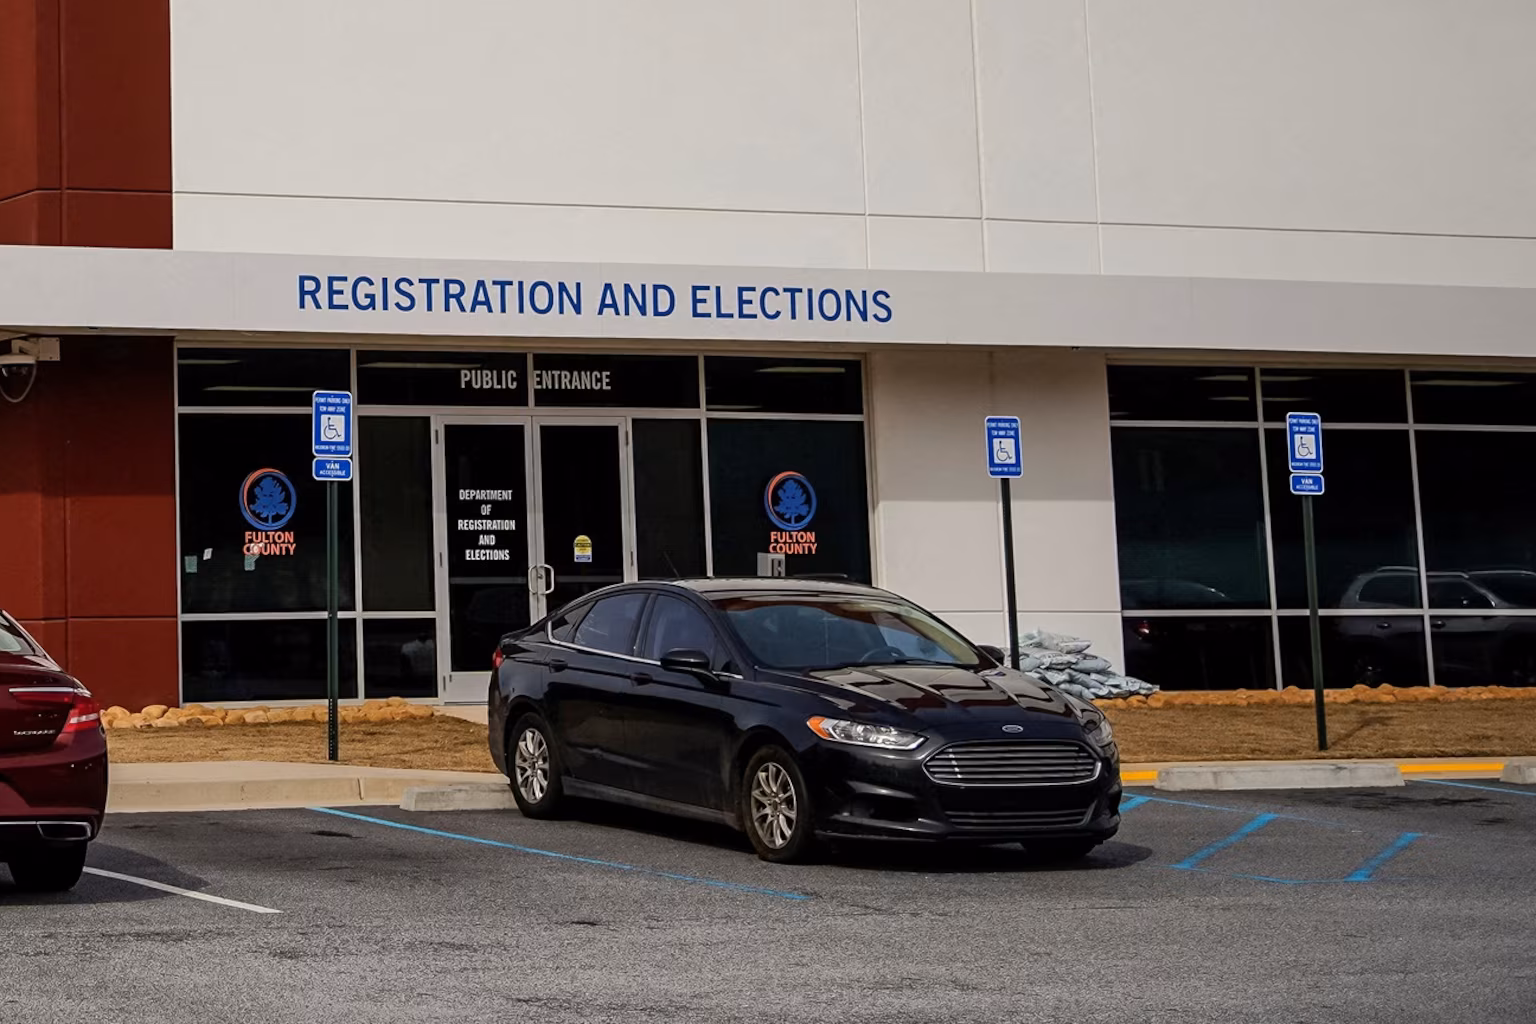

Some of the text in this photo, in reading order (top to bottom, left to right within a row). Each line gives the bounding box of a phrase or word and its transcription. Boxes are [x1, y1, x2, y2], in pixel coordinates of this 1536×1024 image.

[298, 274, 893, 324] REGISTRATION AND ELECTIONS
[460, 369, 612, 391] PUBLIC ENTRANCE
[459, 489, 513, 501] DEPARTMENT
[480, 504, 492, 516] OF
[457, 519, 516, 531] REGISTRATION
[244, 531, 294, 543] FULTON
[478, 534, 496, 546] AND
[770, 531, 816, 543] FULTON
[243, 543, 297, 556] COUNTY
[465, 549, 510, 561] ELECTIONS
[769, 543, 818, 555] COUNTY
